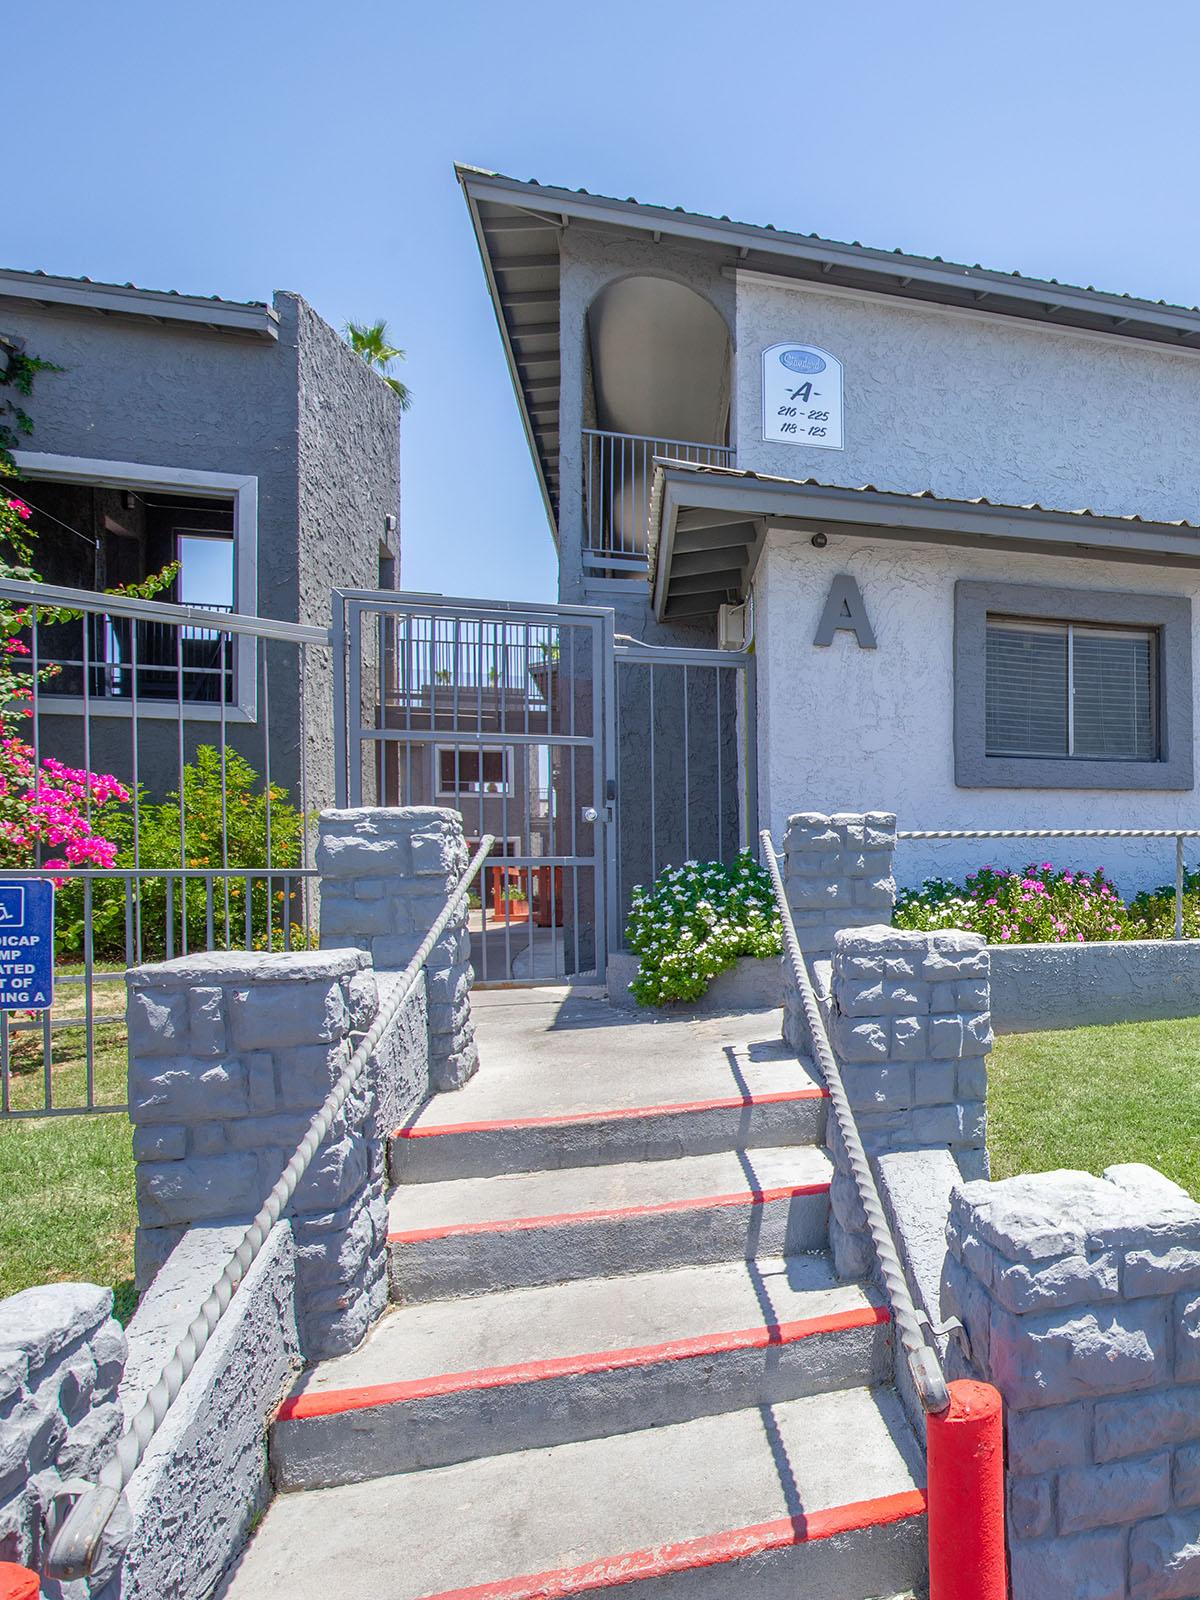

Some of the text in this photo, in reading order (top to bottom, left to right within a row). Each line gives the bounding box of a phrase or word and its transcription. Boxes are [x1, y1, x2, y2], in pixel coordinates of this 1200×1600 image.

[777, 405, 797, 417] 216
[807, 409, 830, 421] 225
[780, 422, 797, 434] 118
[808, 426, 827, 437] 125
[813, 573, 878, 650] A
[11, 977, 33, 989] OF
[34, 991, 46, 1003] A
